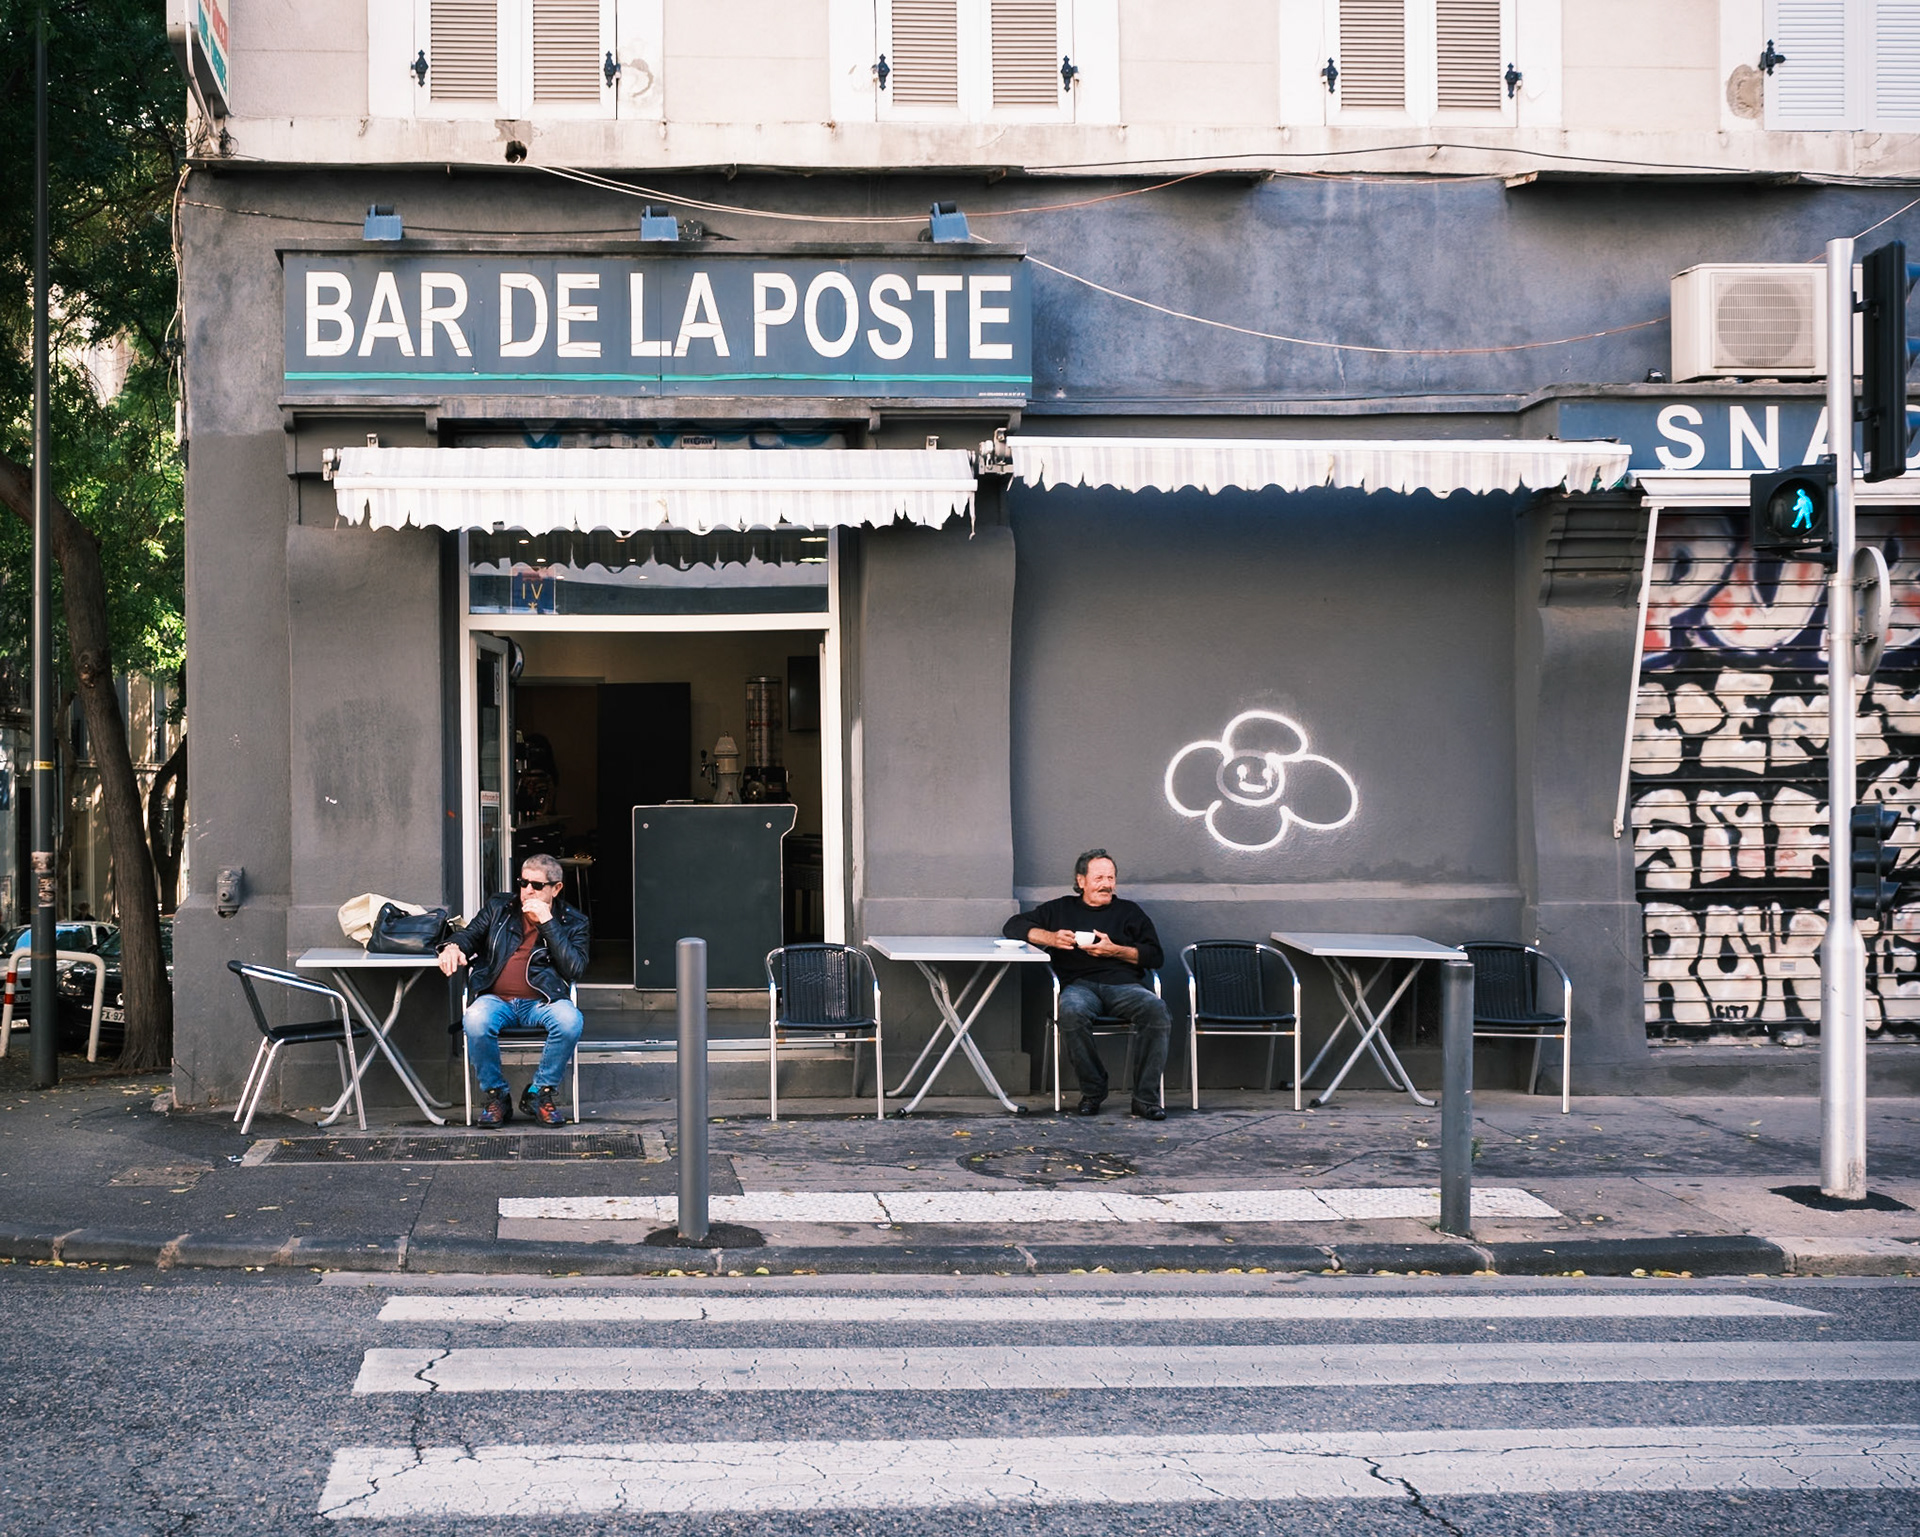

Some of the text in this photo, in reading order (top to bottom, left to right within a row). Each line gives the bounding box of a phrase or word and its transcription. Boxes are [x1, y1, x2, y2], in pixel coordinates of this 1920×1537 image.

[304, 270, 1013, 360] BAR DE LA POSTE
[1655, 404, 1920, 469] SNA
[522, 583, 543, 600] IV
